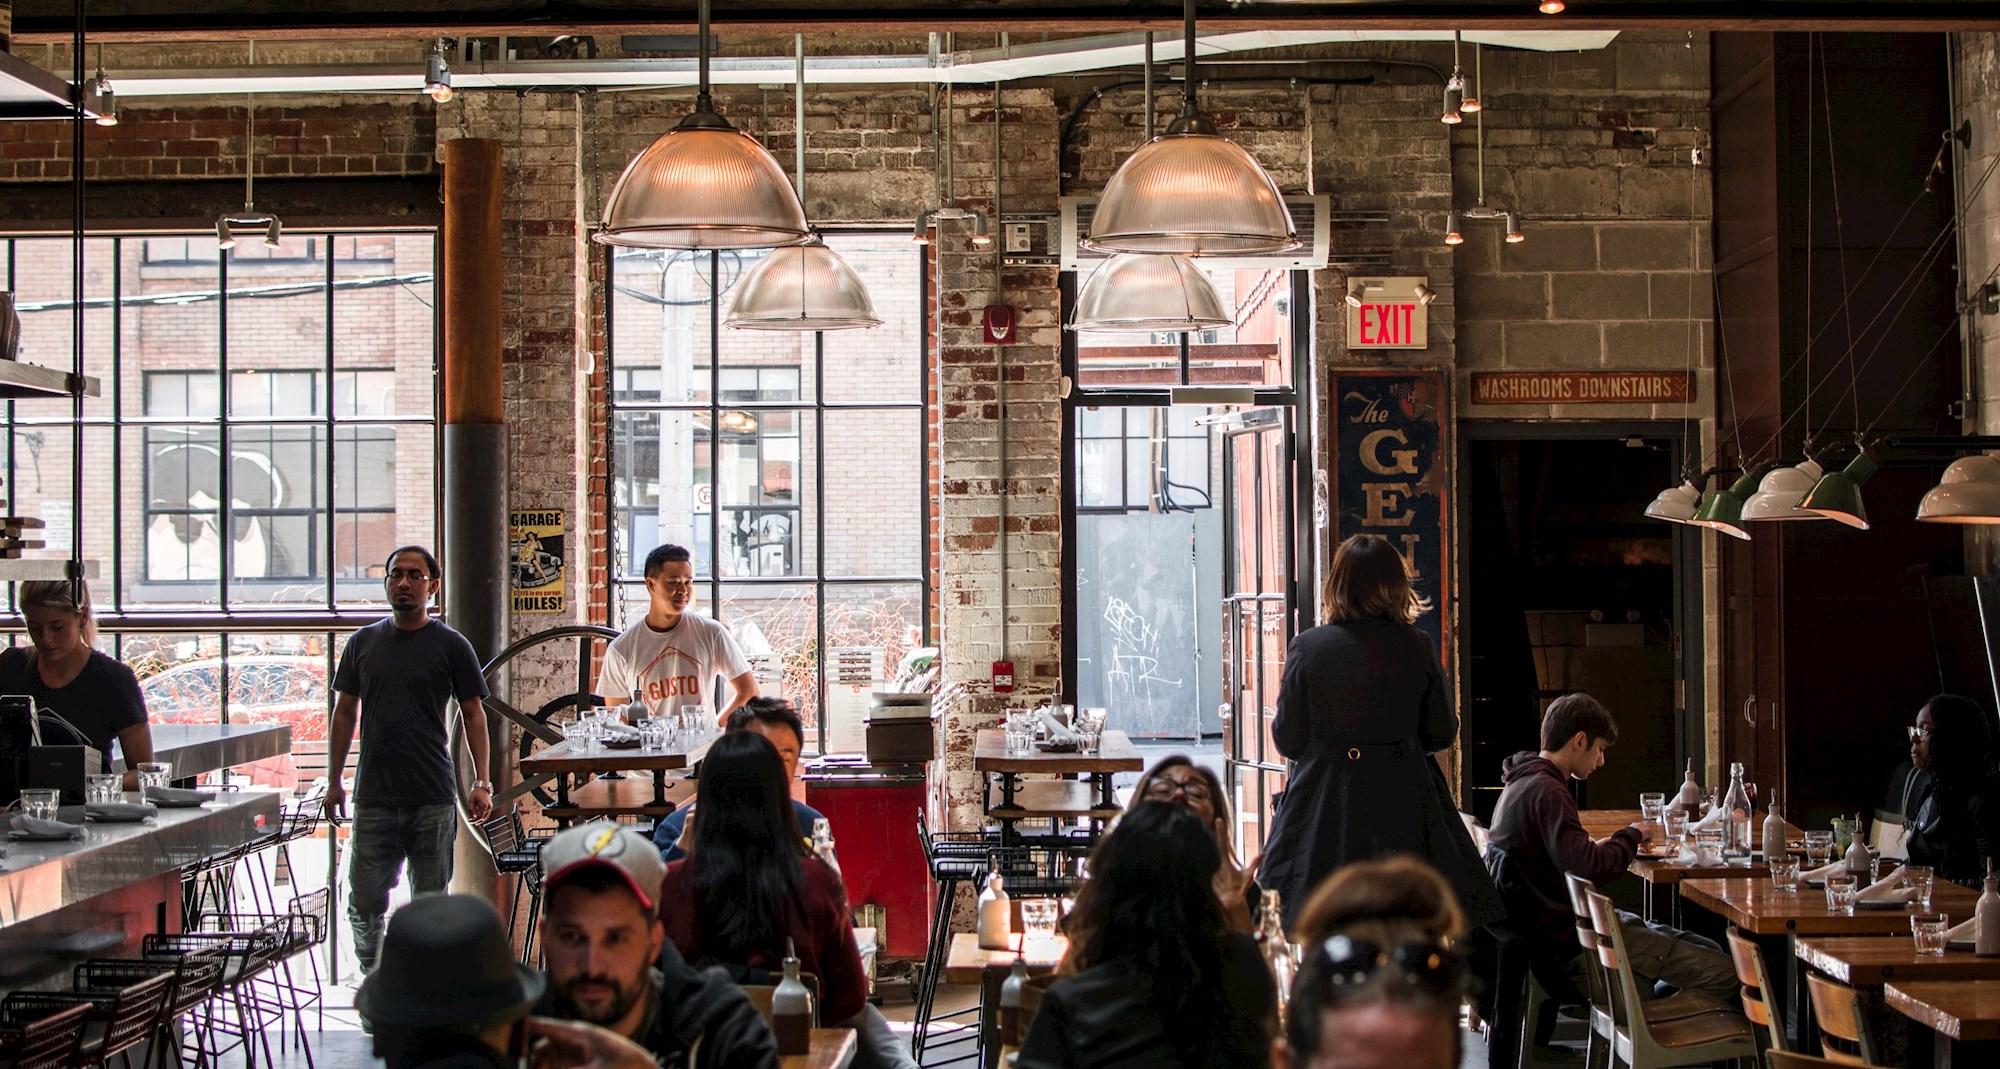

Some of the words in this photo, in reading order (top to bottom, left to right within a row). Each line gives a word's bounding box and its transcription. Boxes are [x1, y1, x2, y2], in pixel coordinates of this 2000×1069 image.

[1360, 304, 1416, 344] EXIT
[1479, 378, 1572, 399] WASHROOMS
[1579, 376, 1672, 398] DOWNSTAIRS
[1343, 391, 1389, 424] The
[511, 512, 561, 527] GARAGE
[648, 675, 699, 701] GUSTO
